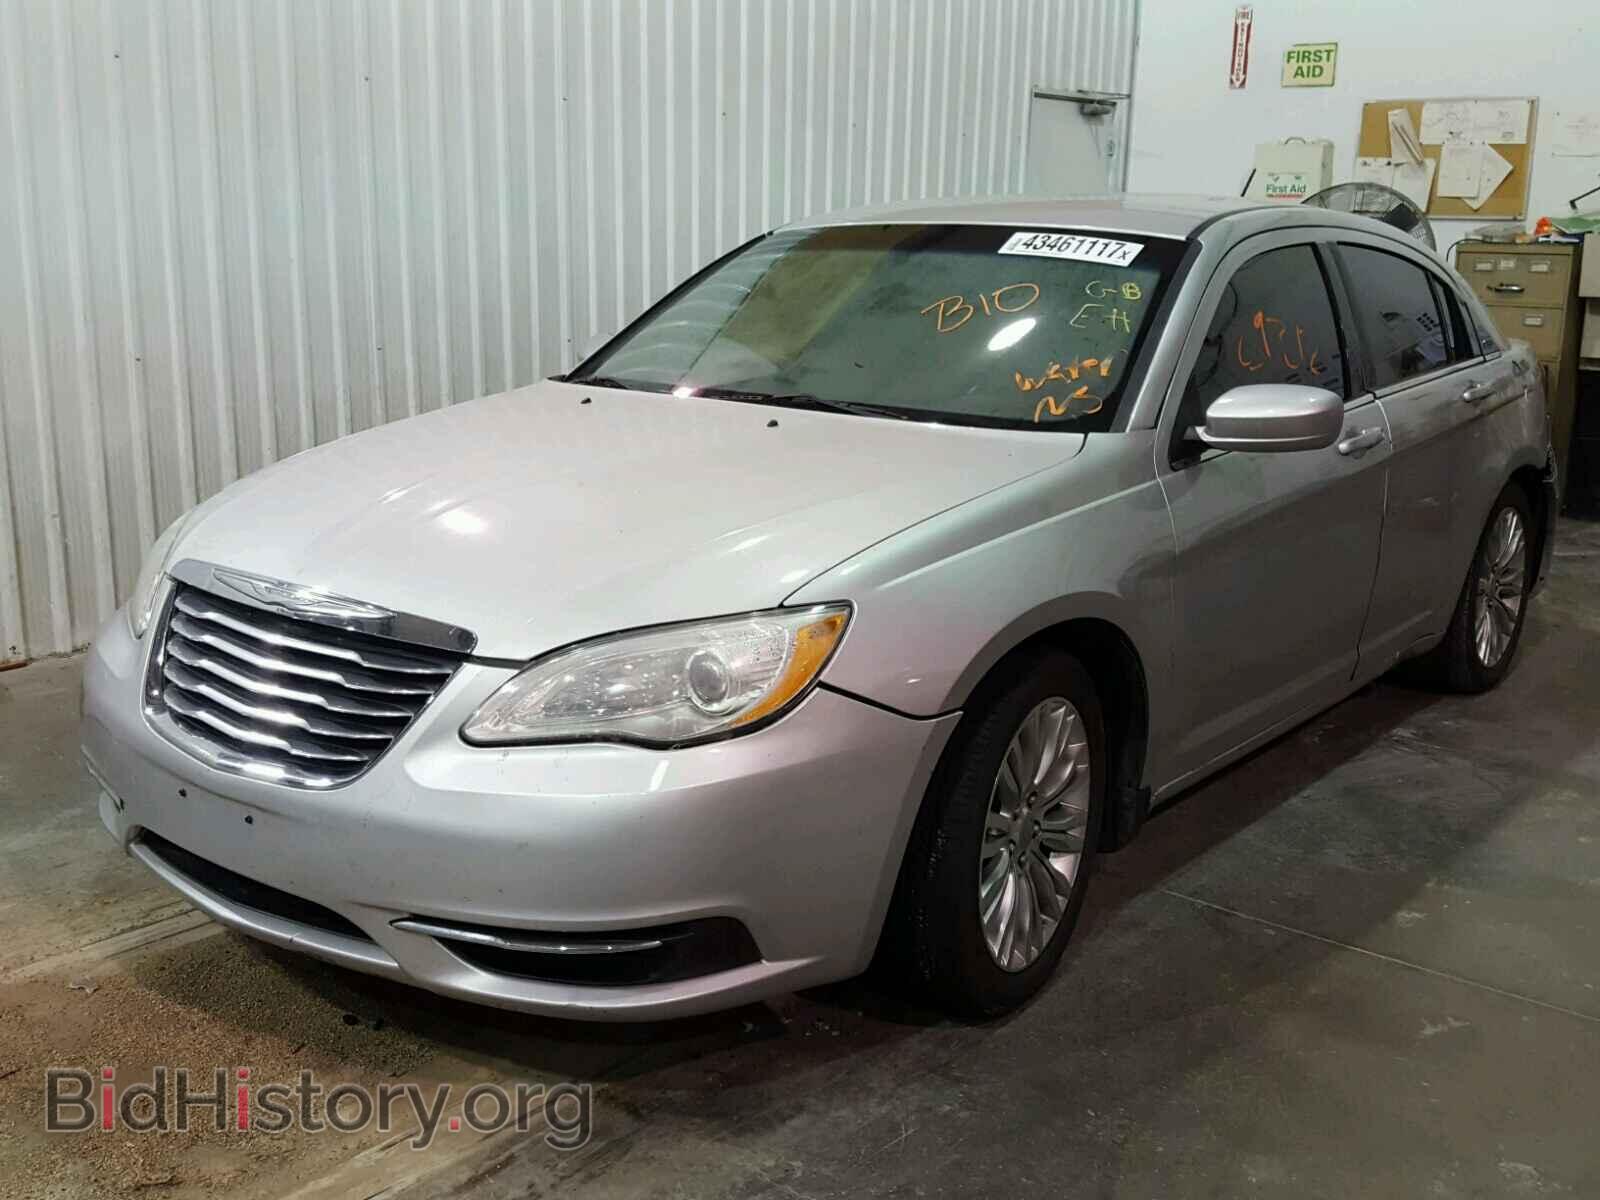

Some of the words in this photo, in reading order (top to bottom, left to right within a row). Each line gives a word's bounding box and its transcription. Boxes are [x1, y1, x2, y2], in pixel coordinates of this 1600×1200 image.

[1286, 49, 1334, 64] FIRST
[1293, 65, 1324, 78] AID
[1266, 184, 1288, 193] First
[1290, 184, 1306, 193] Aid
